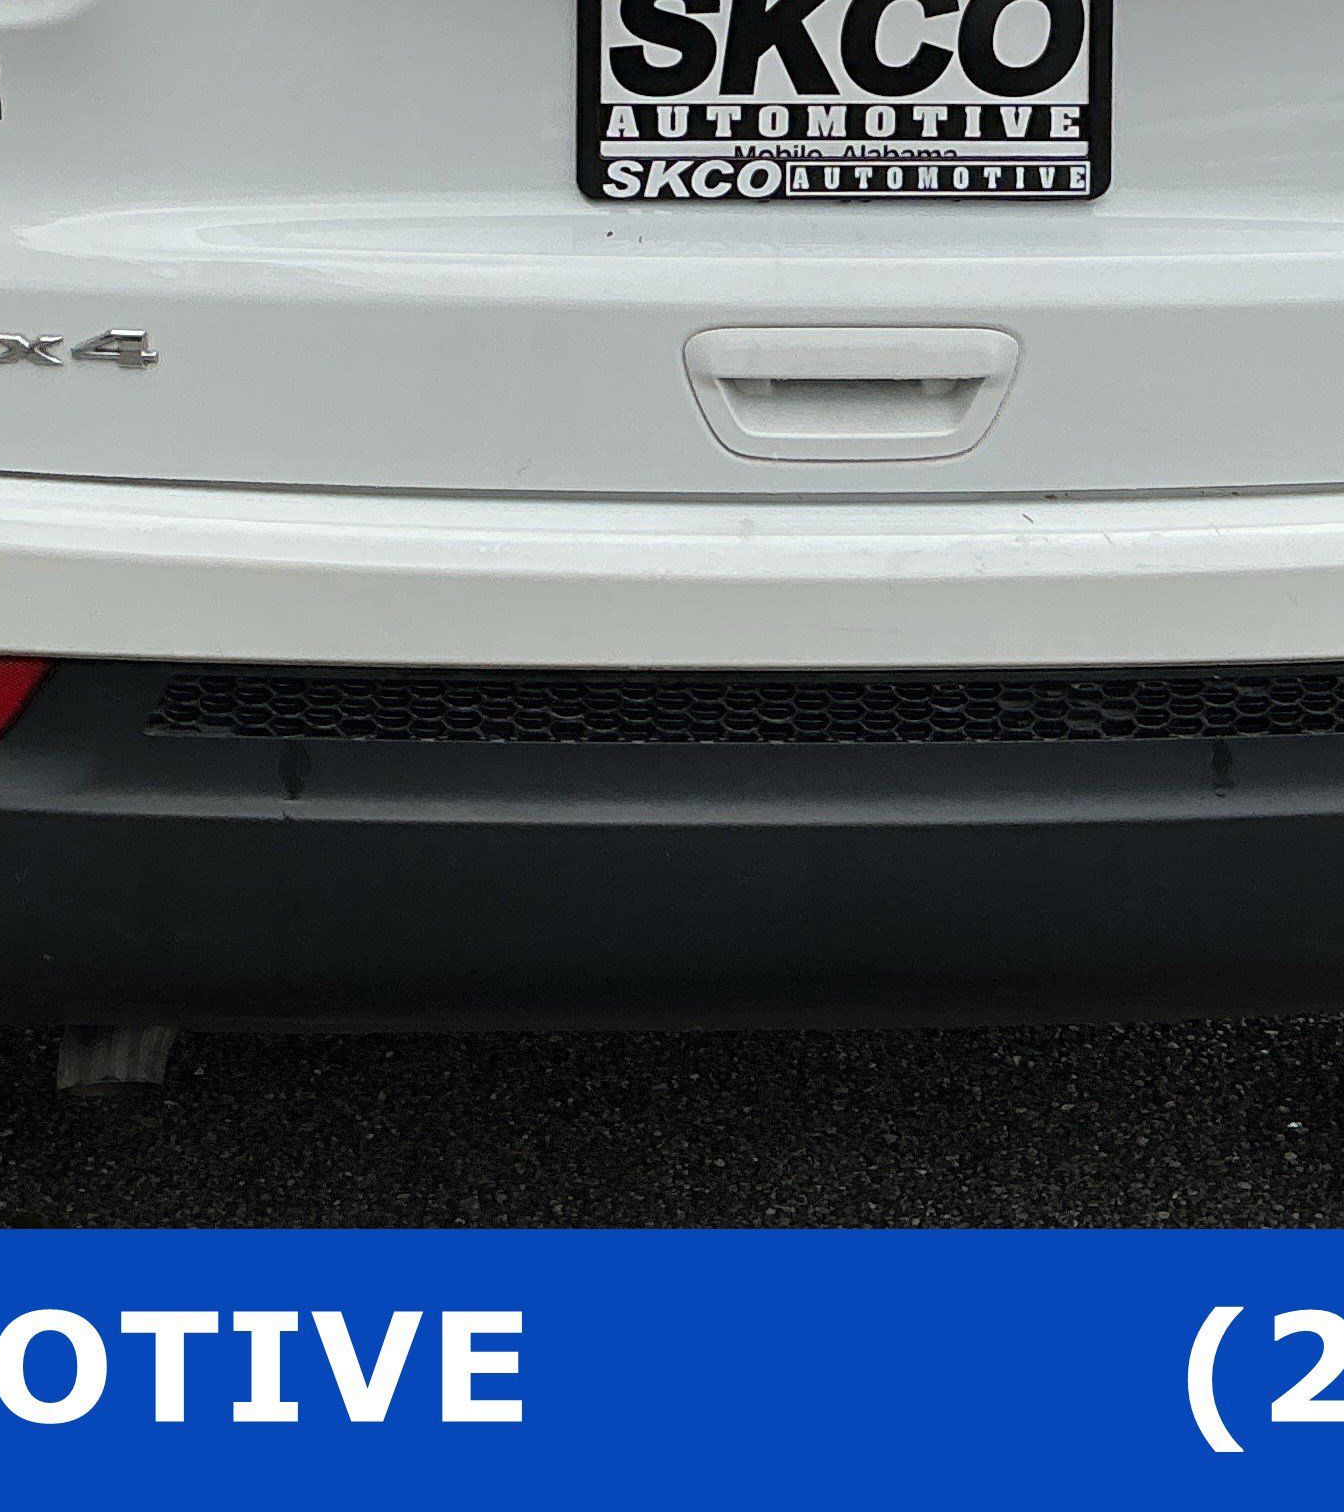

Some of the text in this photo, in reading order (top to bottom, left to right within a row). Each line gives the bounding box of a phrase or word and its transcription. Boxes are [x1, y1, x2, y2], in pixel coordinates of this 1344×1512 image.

[606, 104, 1080, 138] AUTOMOTIVE
[734, 145, 959, 158] Mobile Alabama
[602, 160, 1088, 198] SKCO AUTOMOTIVE
